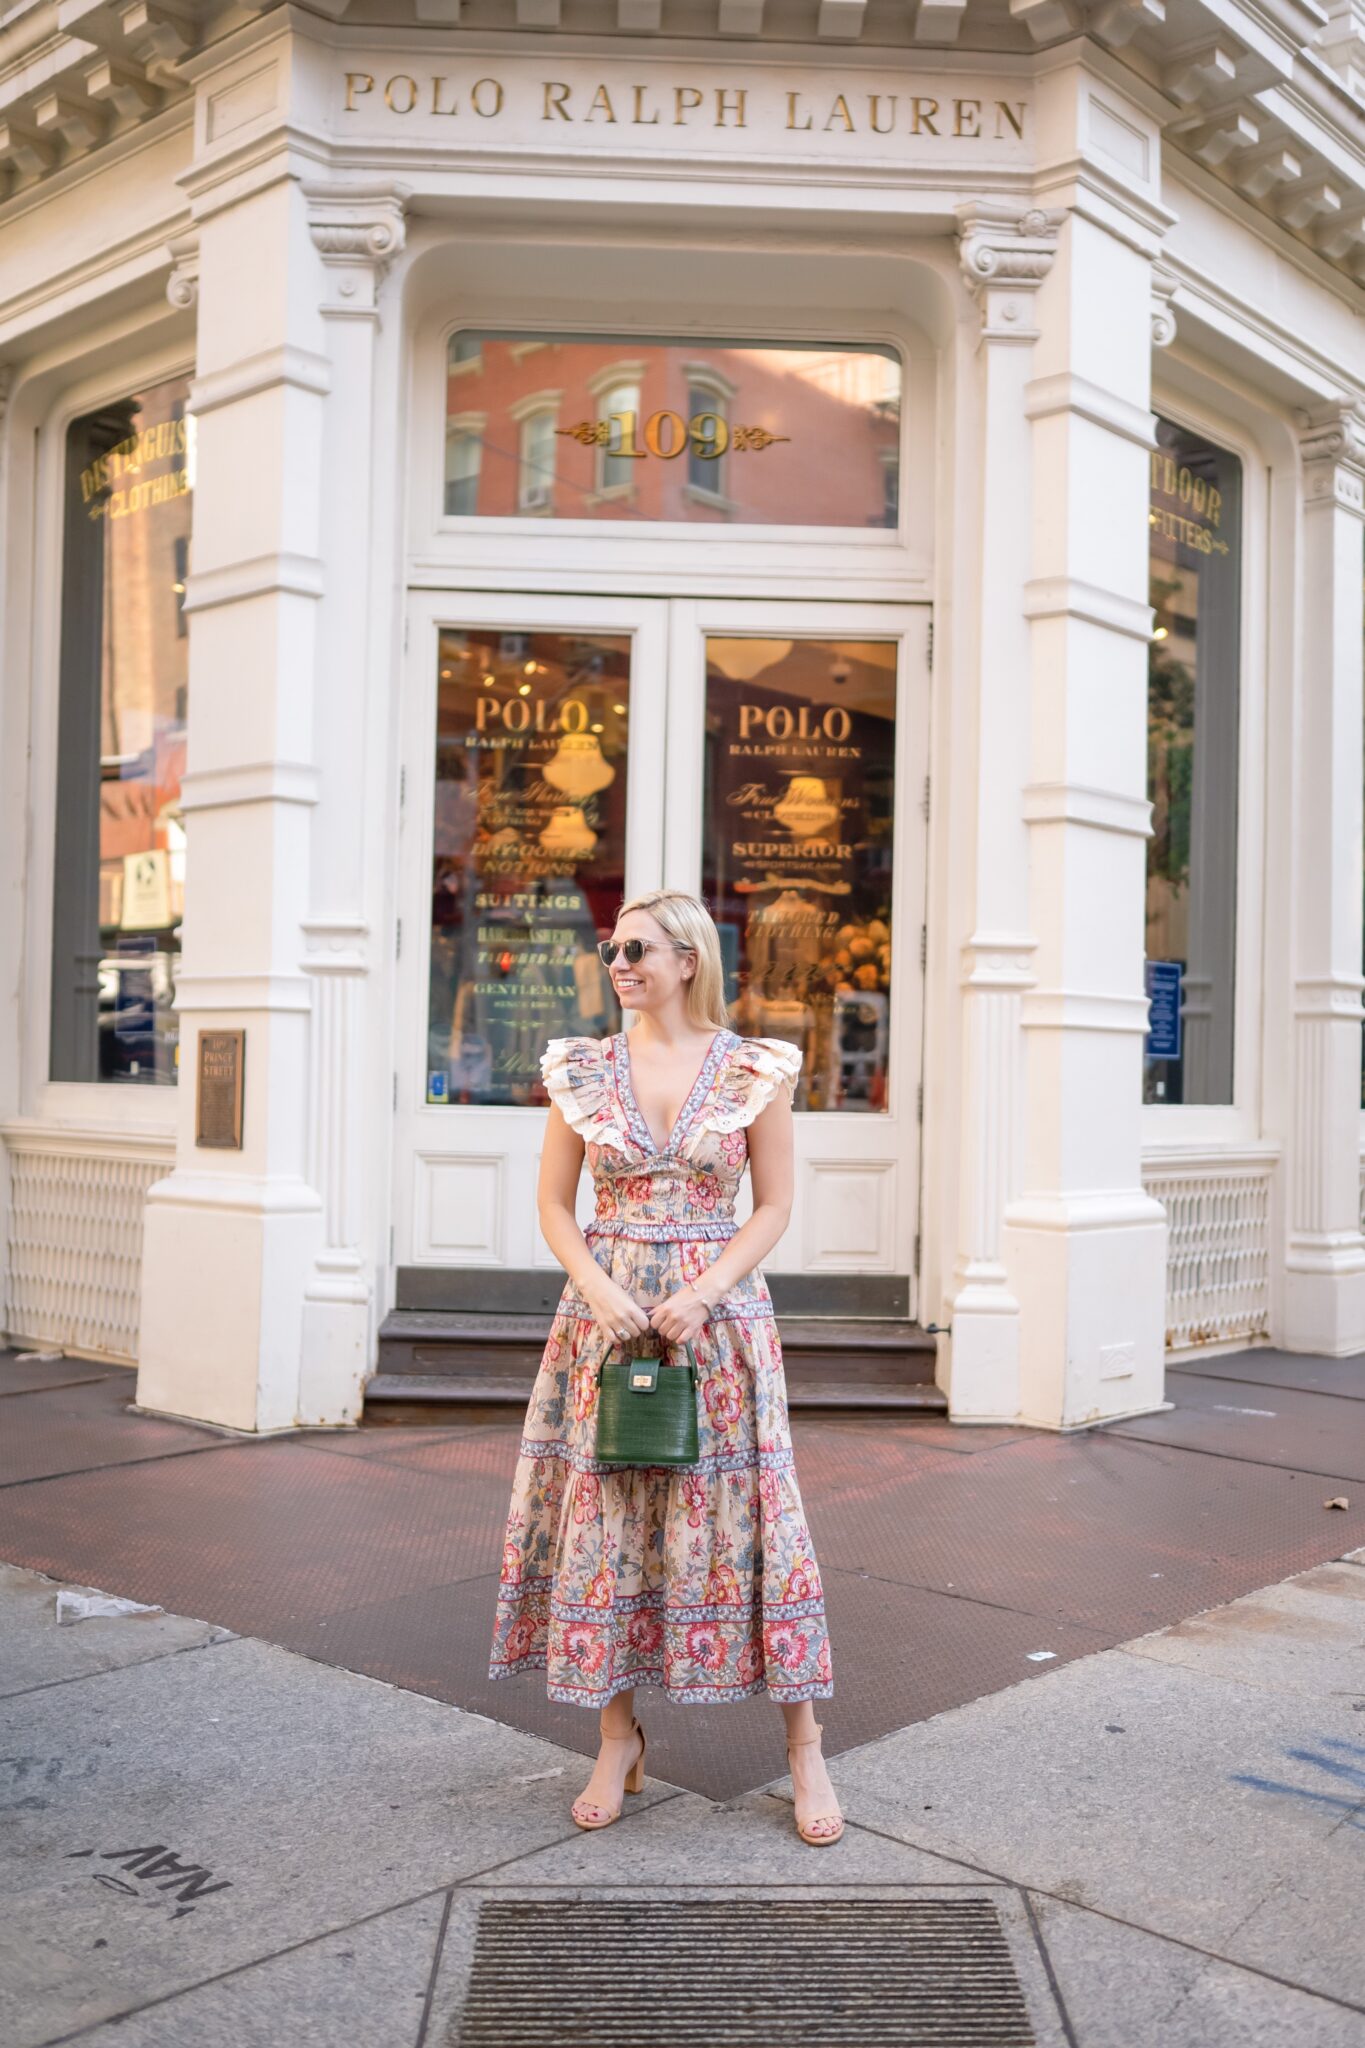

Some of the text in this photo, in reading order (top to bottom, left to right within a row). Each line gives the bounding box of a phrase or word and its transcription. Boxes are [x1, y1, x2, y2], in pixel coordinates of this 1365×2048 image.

[342, 72, 1029, 140] POLO RALPH LAUREN
[608, 410, 729, 459] 109
[476, 697, 589, 734] POLO
[738, 705, 852, 741] POLO
[465, 736, 524, 749] RALPH
[729, 744, 861, 758] RALPH LAUREN
[732, 842, 853, 859] SUPERIOR
[474, 893, 581, 910] SUITINGS
[473, 983, 576, 997] GENTLEMAN
